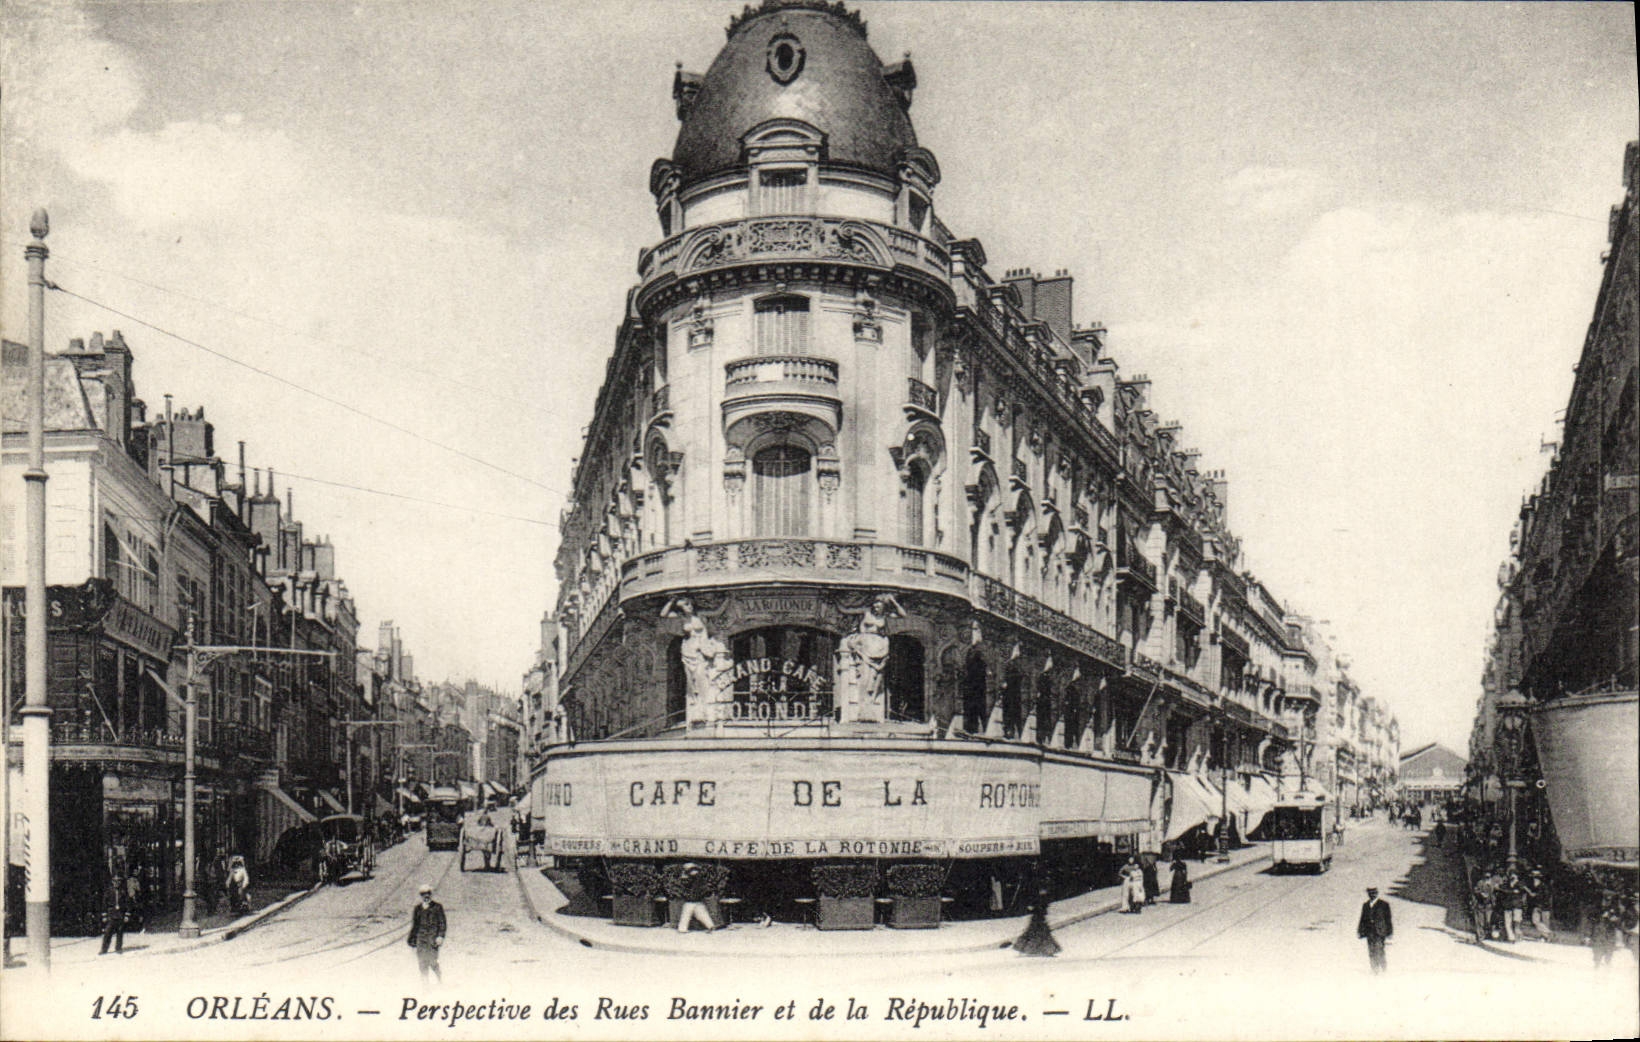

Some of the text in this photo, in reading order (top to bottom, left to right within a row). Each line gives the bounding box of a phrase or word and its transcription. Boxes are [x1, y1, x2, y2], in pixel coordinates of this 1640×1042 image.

[731, 701, 822, 720] OTONDE
[629, 779, 717, 807] CAFE
[792, 780, 842, 807] DE
[883, 780, 929, 806] LA
[623, 838, 678, 854] GRAND
[704, 840, 759, 855] CAFE
[770, 841, 795, 855] DE
[805, 840, 829, 854] LA
[839, 841, 922, 855] ROTONDE
